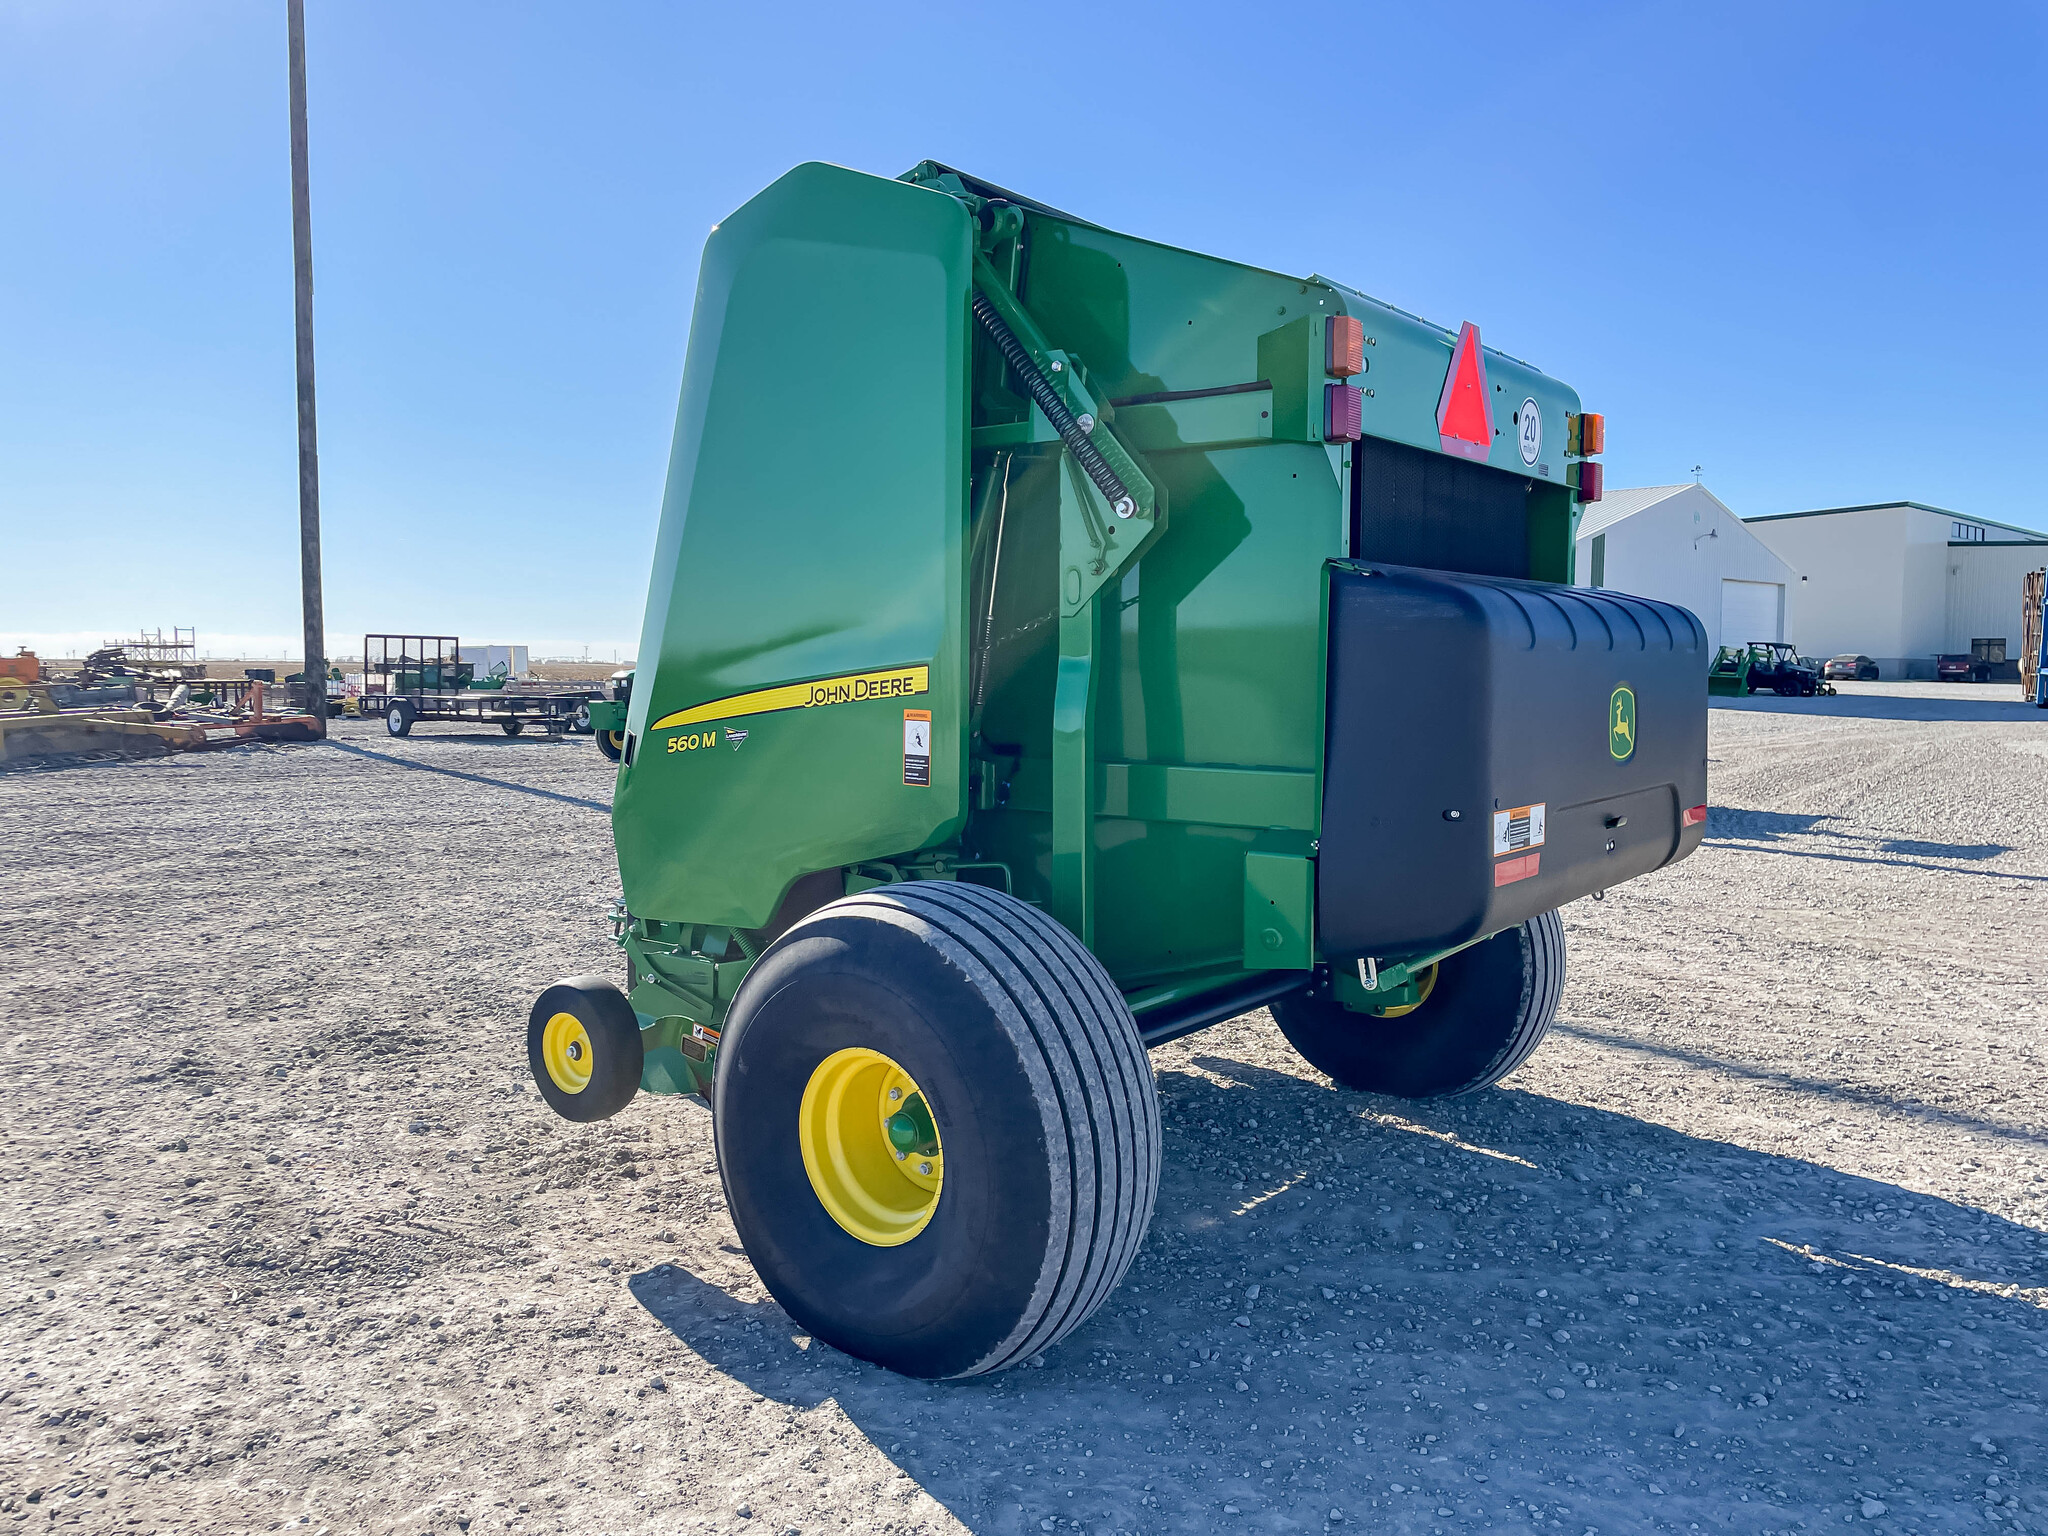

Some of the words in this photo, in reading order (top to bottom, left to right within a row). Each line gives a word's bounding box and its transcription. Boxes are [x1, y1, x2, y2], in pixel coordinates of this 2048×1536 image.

[1524, 413, 1536, 443] 20
[804, 684, 850, 705] JOHN
[855, 676, 914, 699] DEERE
[667, 733, 700, 754] 560
[702, 730, 717, 749] M
